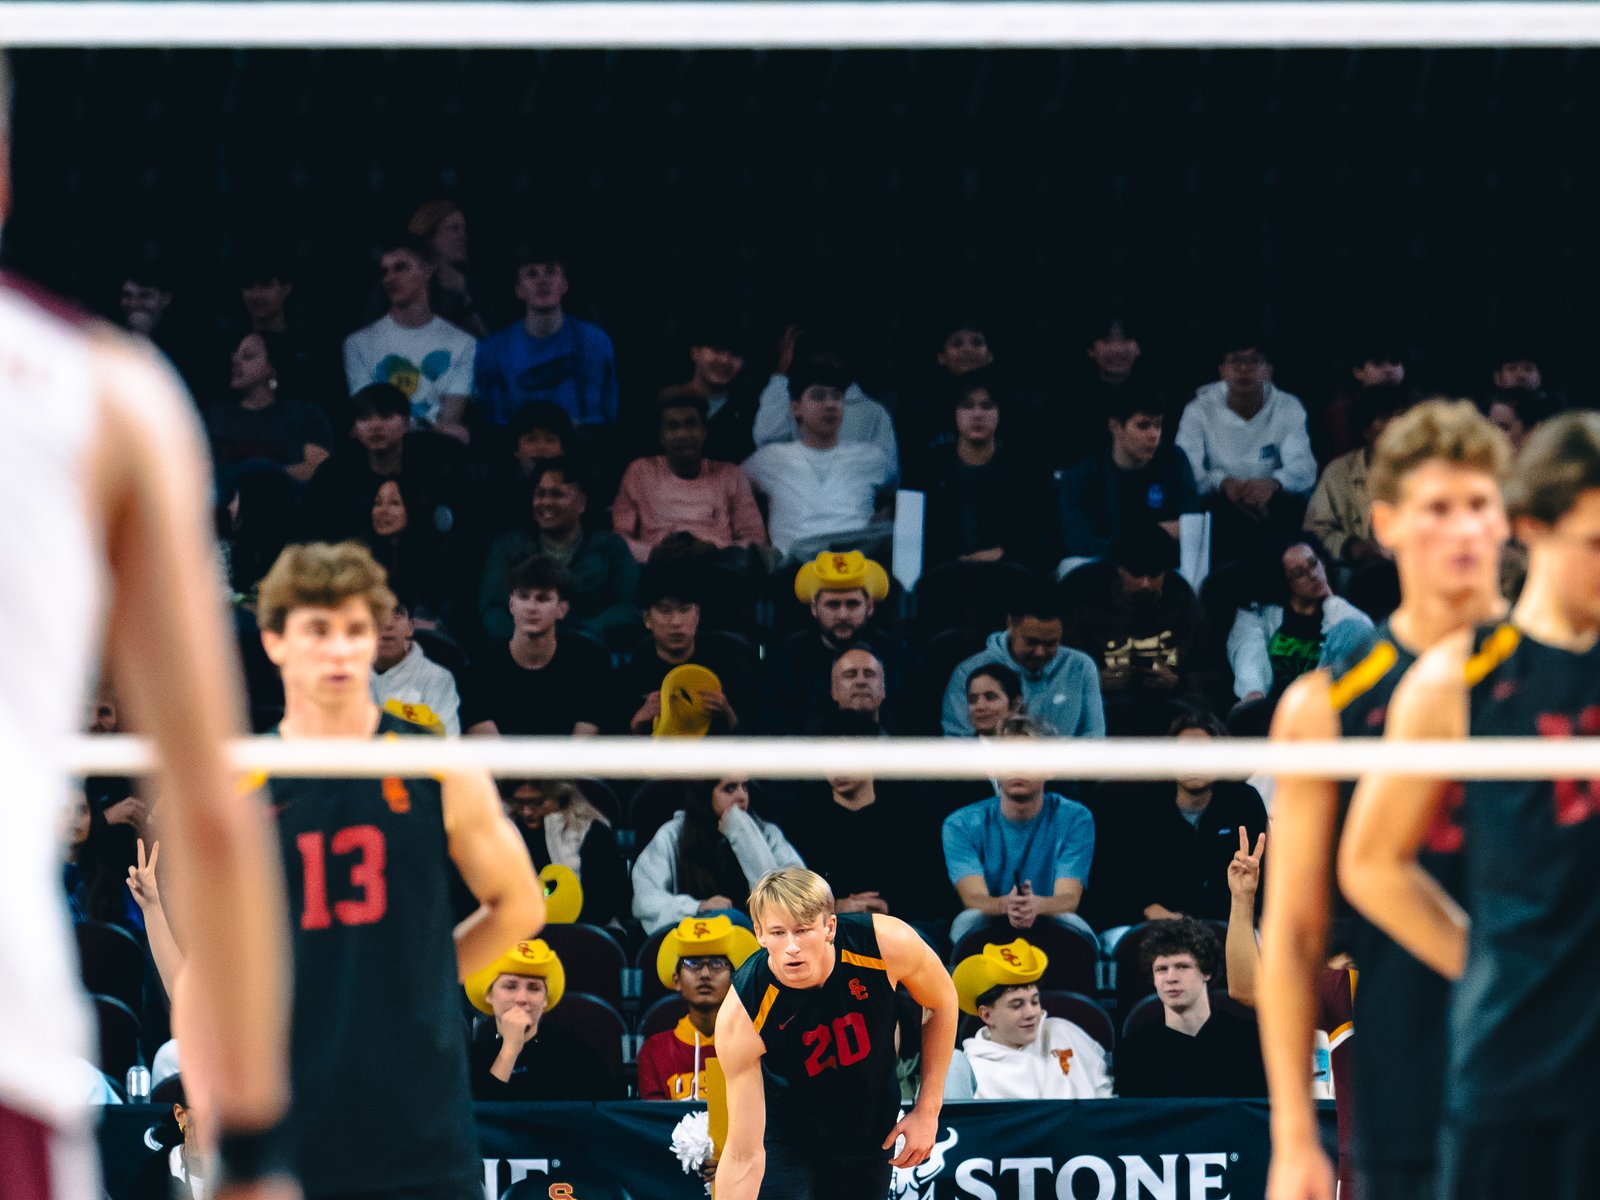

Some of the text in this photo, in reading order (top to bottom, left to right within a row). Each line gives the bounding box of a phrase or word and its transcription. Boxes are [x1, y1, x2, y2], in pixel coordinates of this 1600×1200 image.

[296, 824, 387, 930] 13
[1000, 948, 1022, 967] SC
[848, 978, 869, 1001] SC
[802, 1012, 872, 1077] 20
